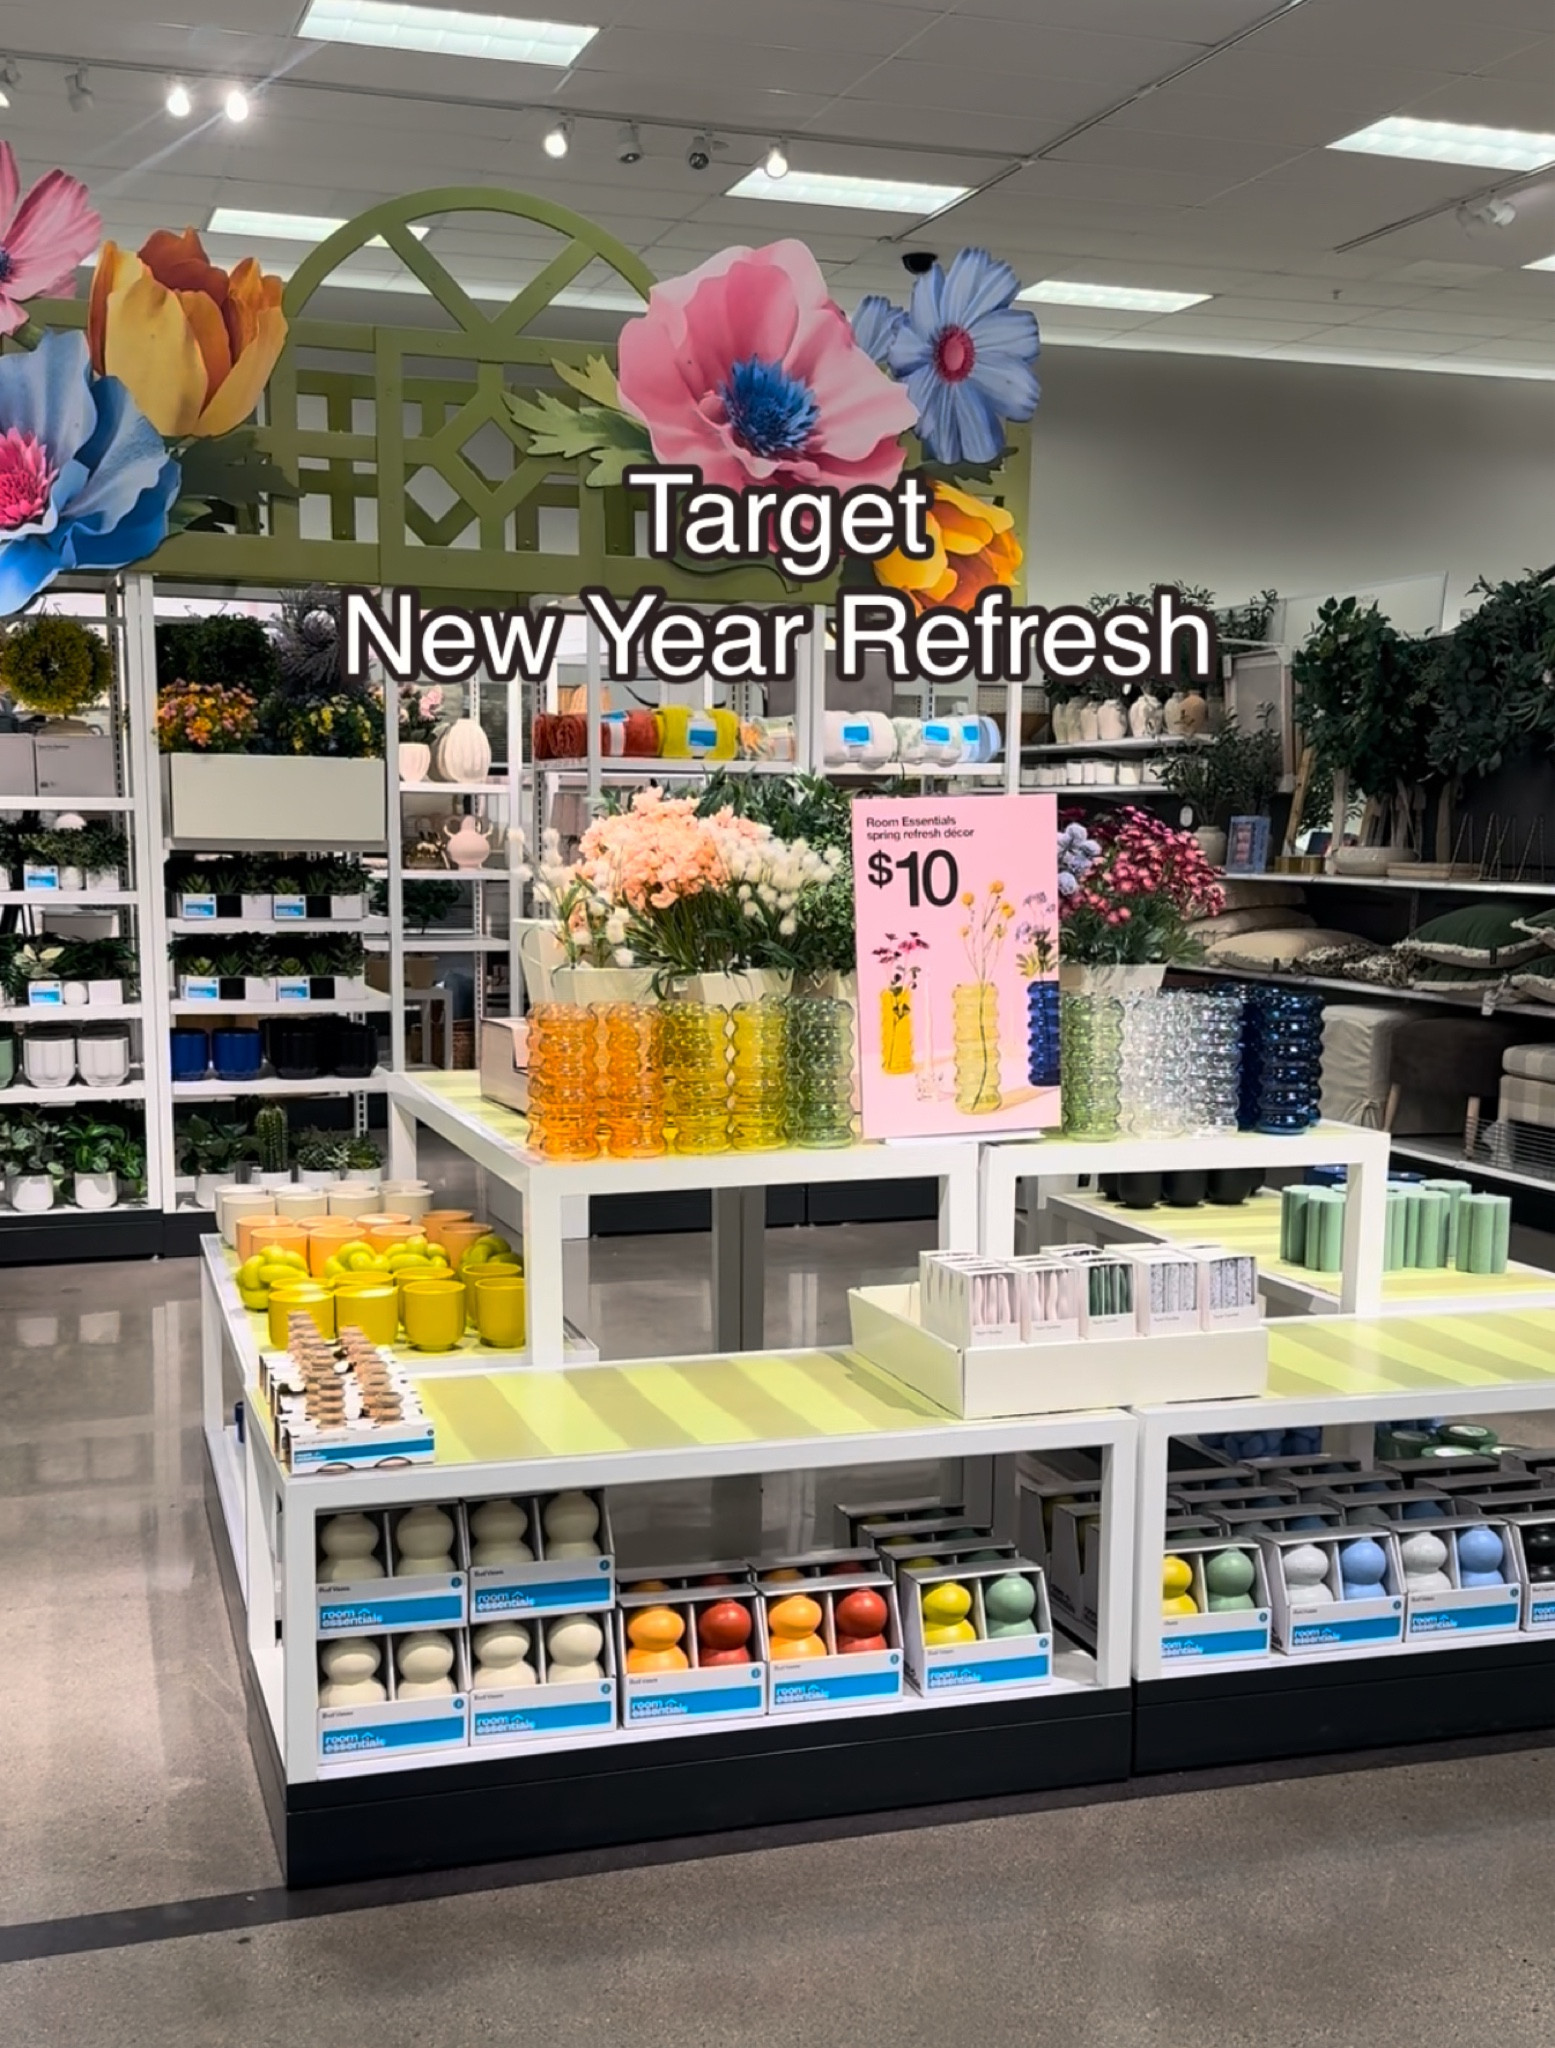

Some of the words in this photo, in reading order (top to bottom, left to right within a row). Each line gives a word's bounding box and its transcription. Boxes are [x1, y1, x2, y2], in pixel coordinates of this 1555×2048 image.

[866, 816, 899, 828] Room
[902, 815, 956, 827] Essentials
[867, 831, 901, 842] spring
[903, 828, 941, 839] refresh
[944, 827, 975, 838] décor
[867, 849, 959, 908] $10
[477, 1592, 510, 1604] room
[477, 1596, 536, 1611] essentials
[322, 1609, 355, 1620] room
[322, 1612, 383, 1628] essentials
[1161, 1641, 1182, 1651] oom
[776, 1686, 806, 1697] room
[632, 1700, 663, 1710] room
[477, 1716, 510, 1726] room
[325, 1734, 358, 1745] room
[325, 1737, 386, 1753] essentials
